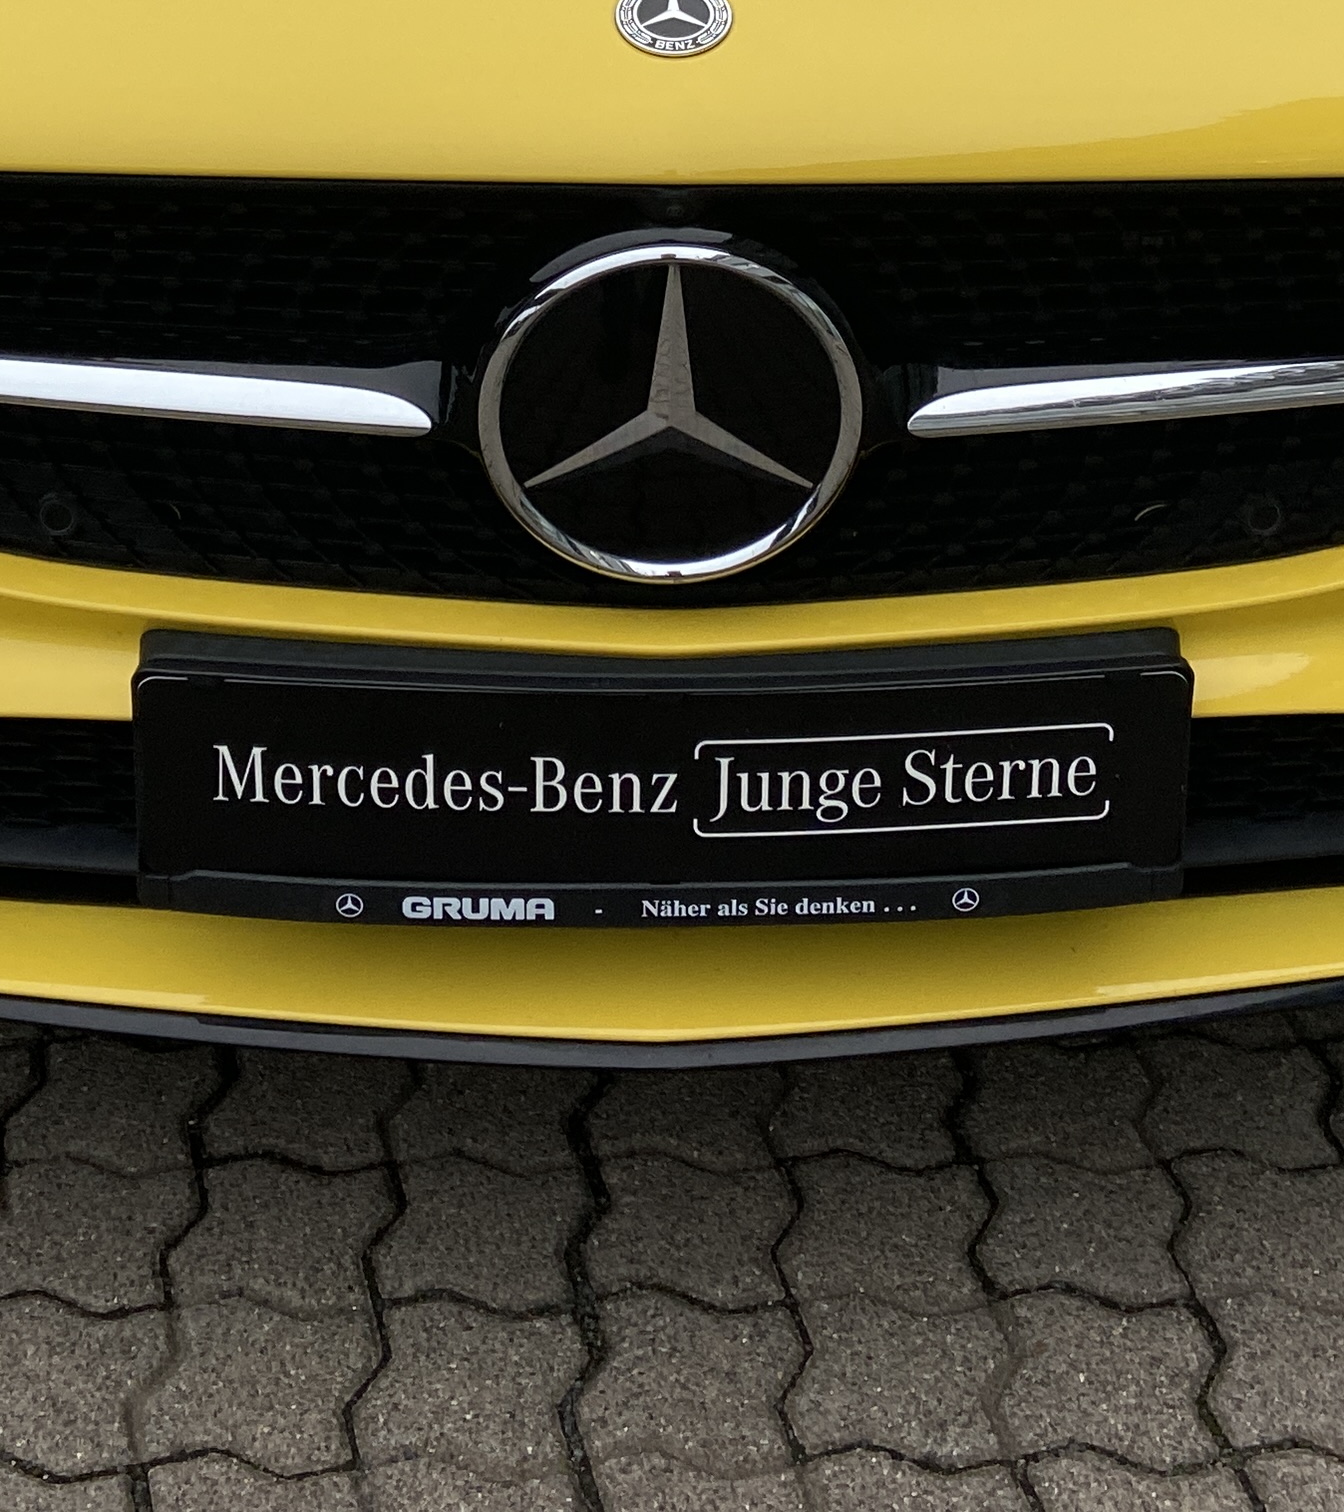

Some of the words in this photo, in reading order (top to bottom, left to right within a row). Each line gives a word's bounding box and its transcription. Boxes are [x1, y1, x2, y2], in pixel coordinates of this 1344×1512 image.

[654, 39, 696, 51] BENZ
[212, 743, 680, 814] Mercedes-Benz
[709, 754, 884, 824] Junge
[901, 747, 1099, 808] Sterne
[402, 895, 557, 922] GRUMA
[640, 898, 711, 918] Näher
[717, 898, 750, 917] als
[754, 897, 789, 917] Sie
[795, 896, 876, 916] denken
